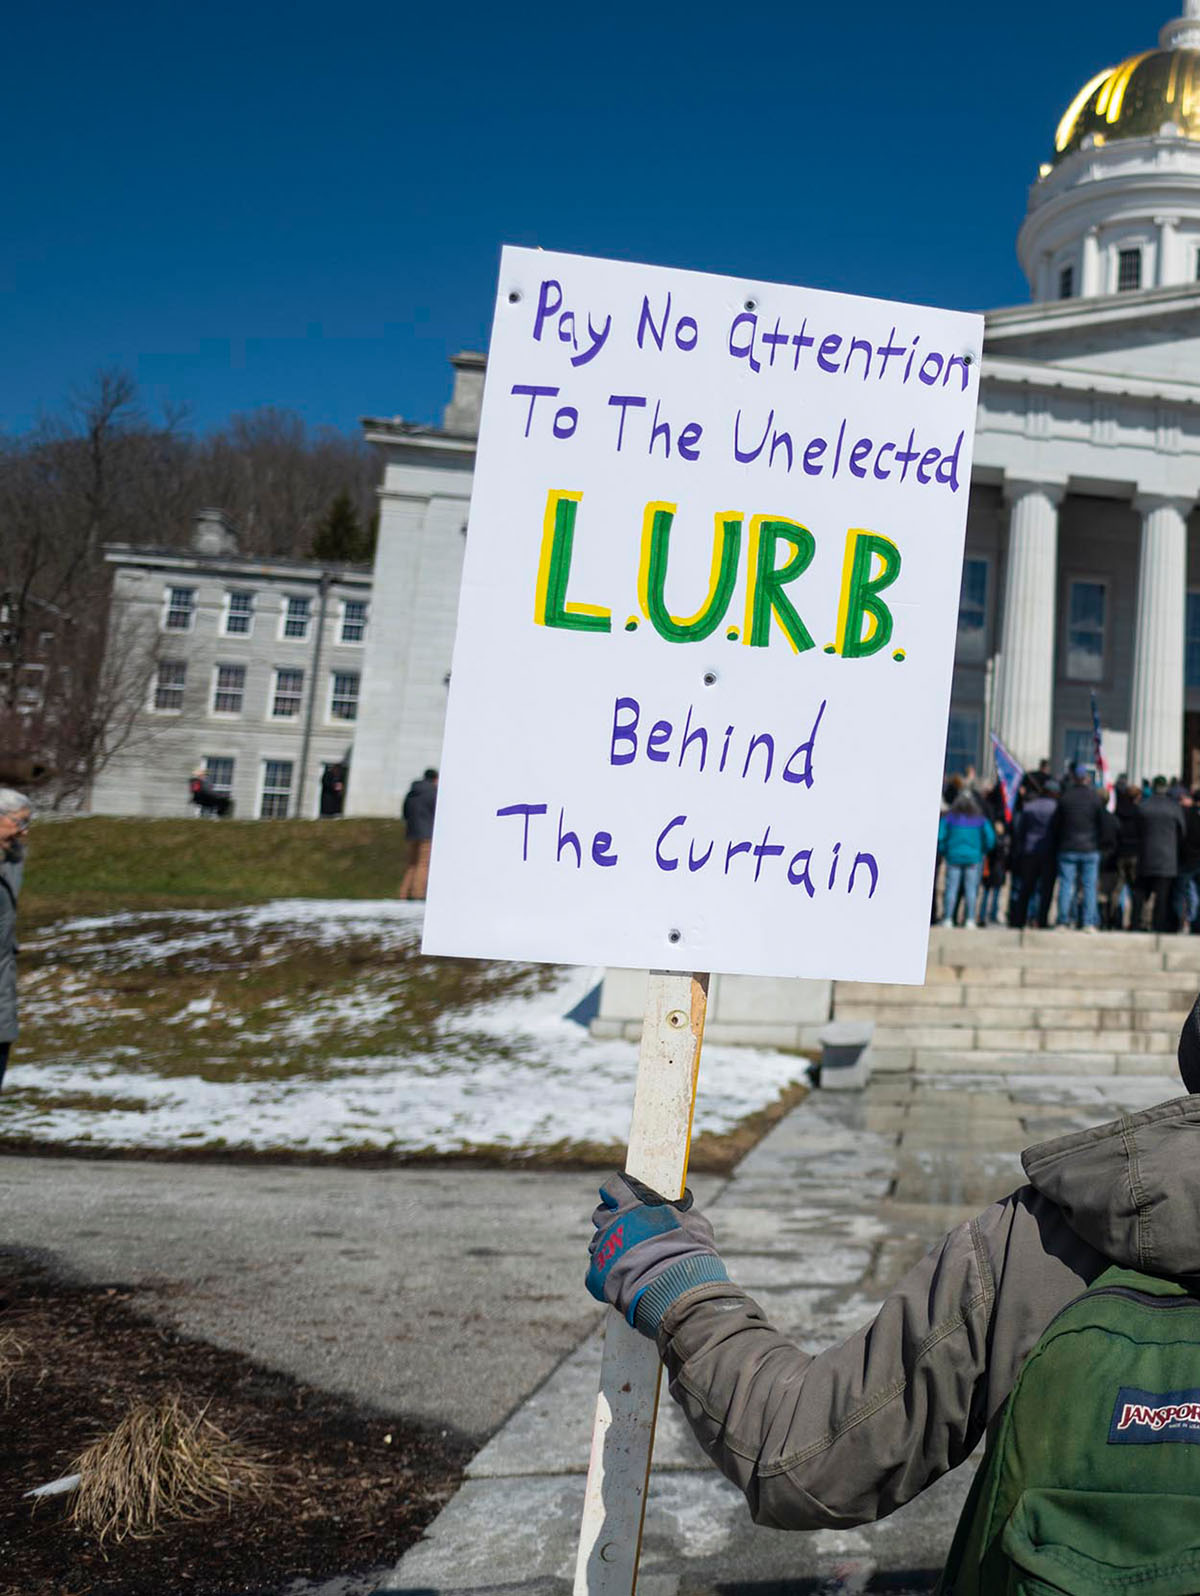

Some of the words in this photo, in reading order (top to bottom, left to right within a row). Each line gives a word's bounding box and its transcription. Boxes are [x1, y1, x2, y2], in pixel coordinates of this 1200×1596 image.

[533, 280, 611, 366] Pay
[638, 293, 697, 350] No
[512, 385, 579, 439] To
[609, 396, 703, 460] The
[735, 410, 963, 492] Unelected
[534, 489, 906, 661] L.U.R.B.
[611, 698, 826, 788] Behind
[497, 804, 617, 868] The
[656, 816, 878, 898] Curtain
